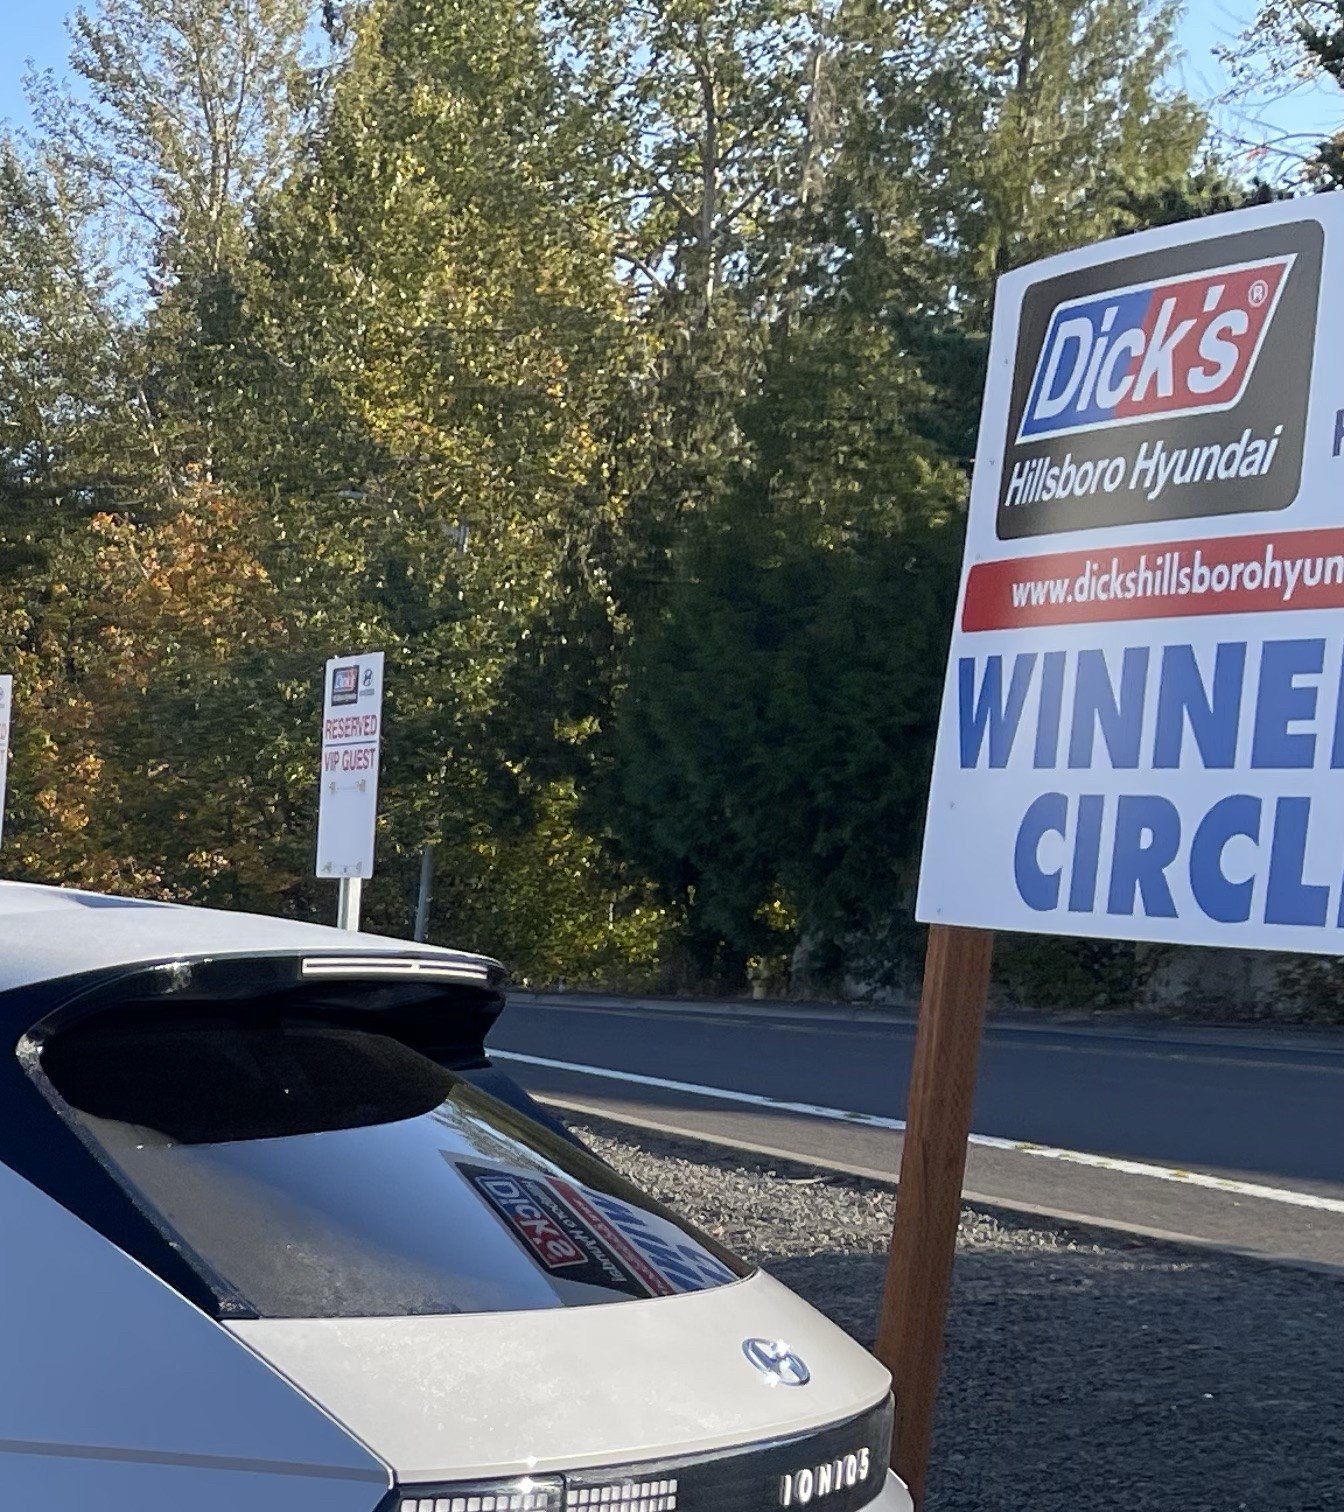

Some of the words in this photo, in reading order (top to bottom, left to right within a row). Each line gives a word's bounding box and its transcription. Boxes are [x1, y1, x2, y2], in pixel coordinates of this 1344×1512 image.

[1004, 453, 1126, 507] Hillsboro
[1128, 424, 1284, 501] Hyundai
[325, 714, 378, 740] RESERVED
[958, 638, 1344, 770] WINNE
[325, 751, 340, 771] VIP
[342, 747, 376, 771] GUEST
[1014, 791, 1344, 928] CIRCL
